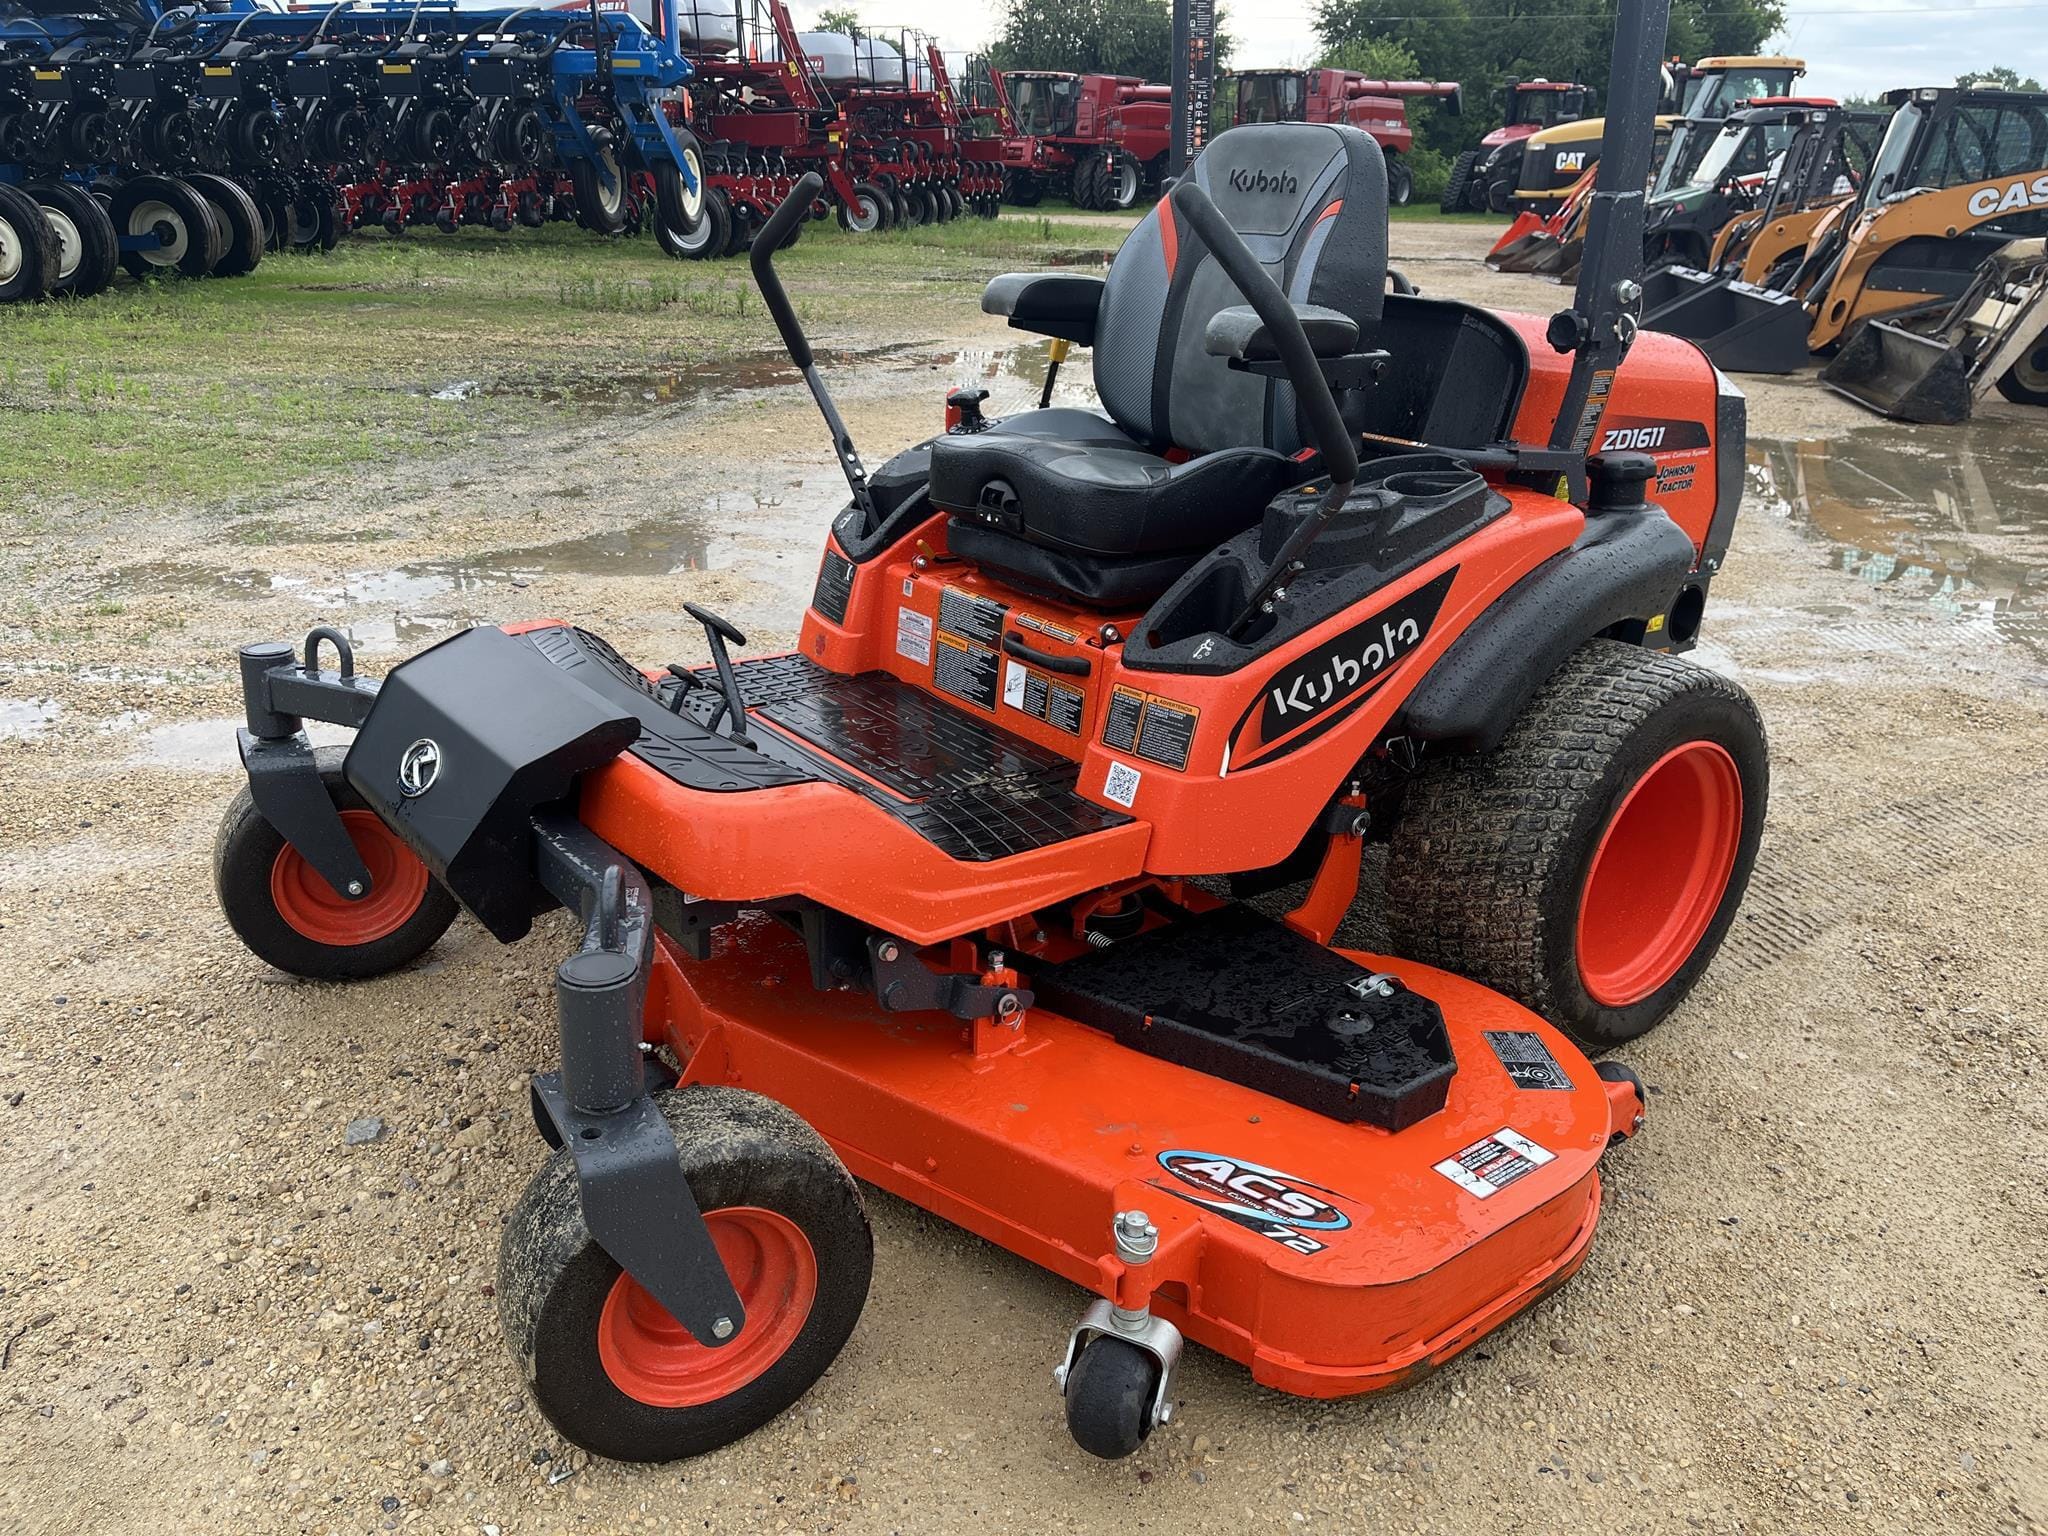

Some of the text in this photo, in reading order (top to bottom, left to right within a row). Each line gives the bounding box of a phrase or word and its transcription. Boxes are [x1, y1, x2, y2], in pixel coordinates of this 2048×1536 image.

[1556, 151, 1586, 170] CAT
[1229, 168, 1298, 194] Kubota
[1600, 426, 1666, 451] ZD1611
[1656, 463, 1697, 480] JOHNSON
[1655, 478, 1693, 495] TRACTOR
[1273, 618, 1420, 716] Kubota
[1170, 1168, 1226, 1194] Aerodynamic
[1227, 1191, 1263, 1210] Cutting
[1179, 1160, 1331, 1218] ACS
[1262, 1223, 1322, 1255] 72
